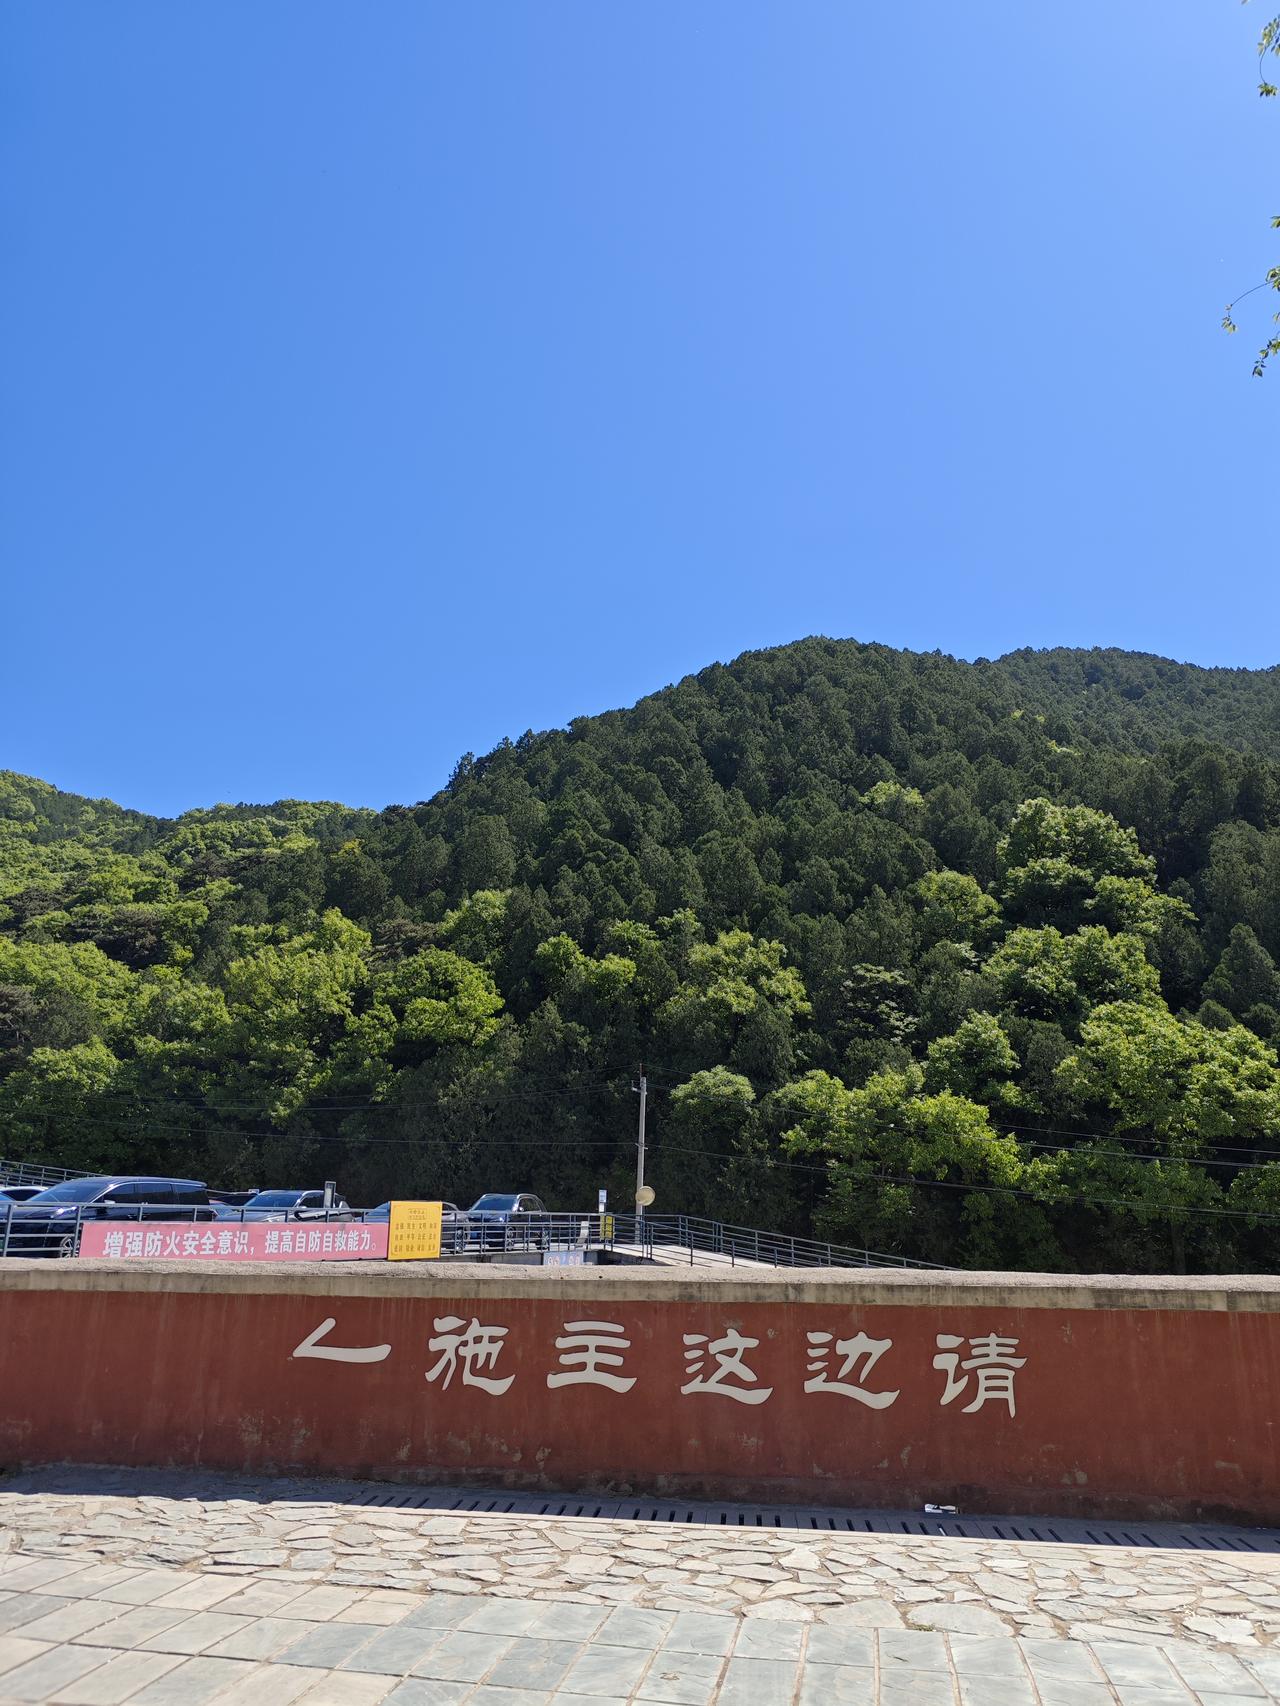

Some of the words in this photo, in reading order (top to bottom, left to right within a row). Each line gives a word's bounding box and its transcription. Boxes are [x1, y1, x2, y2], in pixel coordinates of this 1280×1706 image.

[425, 1317, 1026, 1417] 施主这边请
